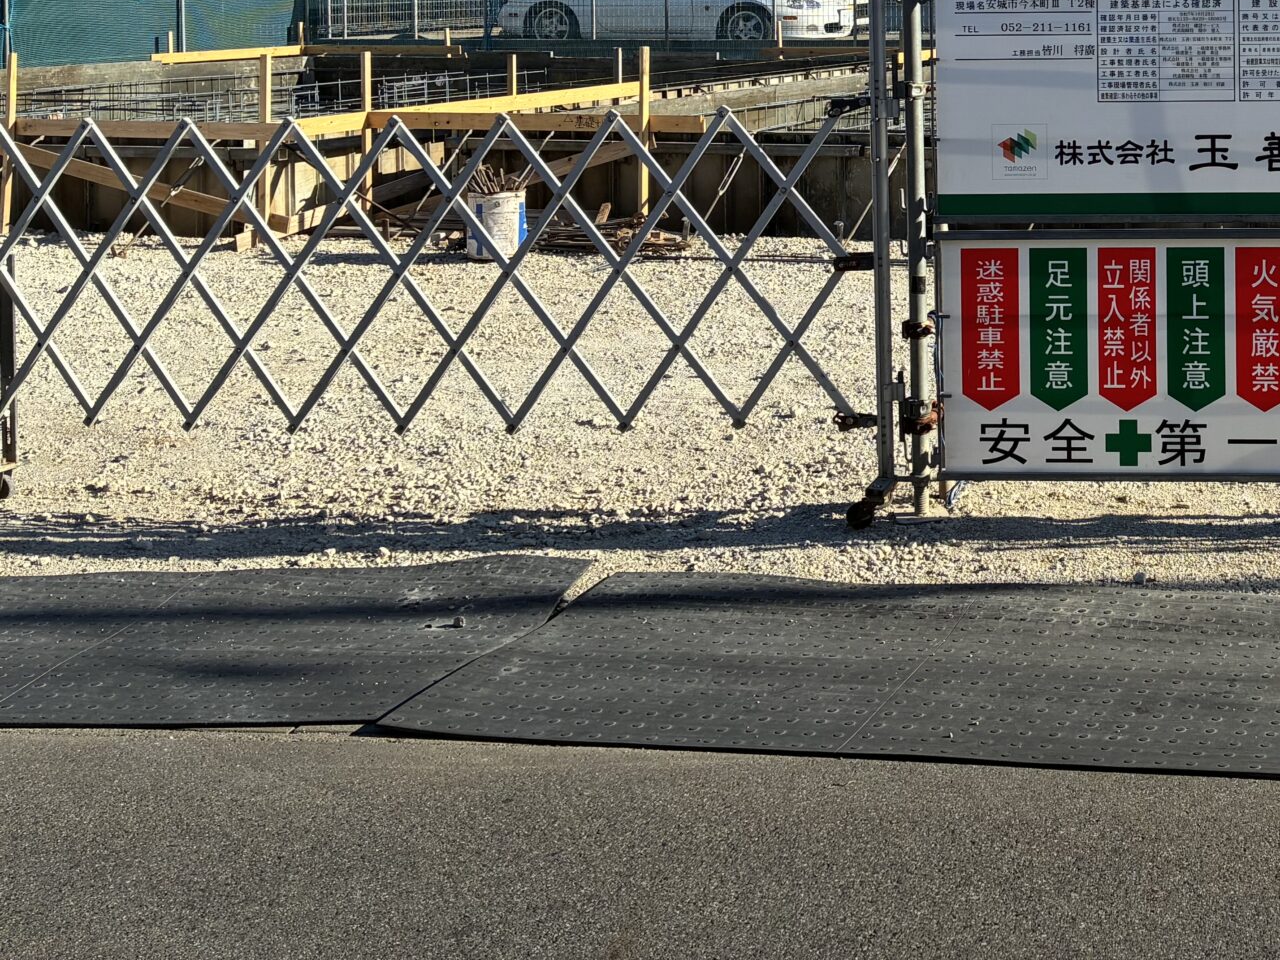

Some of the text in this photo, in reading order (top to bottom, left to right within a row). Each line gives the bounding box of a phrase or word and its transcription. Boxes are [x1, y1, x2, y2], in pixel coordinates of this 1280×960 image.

[955, 1, 985, 10] 現場名
[1001, 23, 1091, 32] 052-211-1161
[1110, 0, 1222, 9] 建築基準法による確認済
[1054, 139, 1176, 166] 株式会社
[975, 259, 1004, 392] 迷惑駐車禁止
[1044, 259, 1074, 391] 足元注意
[1103, 260, 1126, 390] 立入禁止
[1128, 258, 1152, 391] 関係者以外
[1182, 259, 1211, 391] 頭上注意
[1251, 260, 1280, 392] 火気厳禁
[979, 418, 1278, 466] 安全 第一
